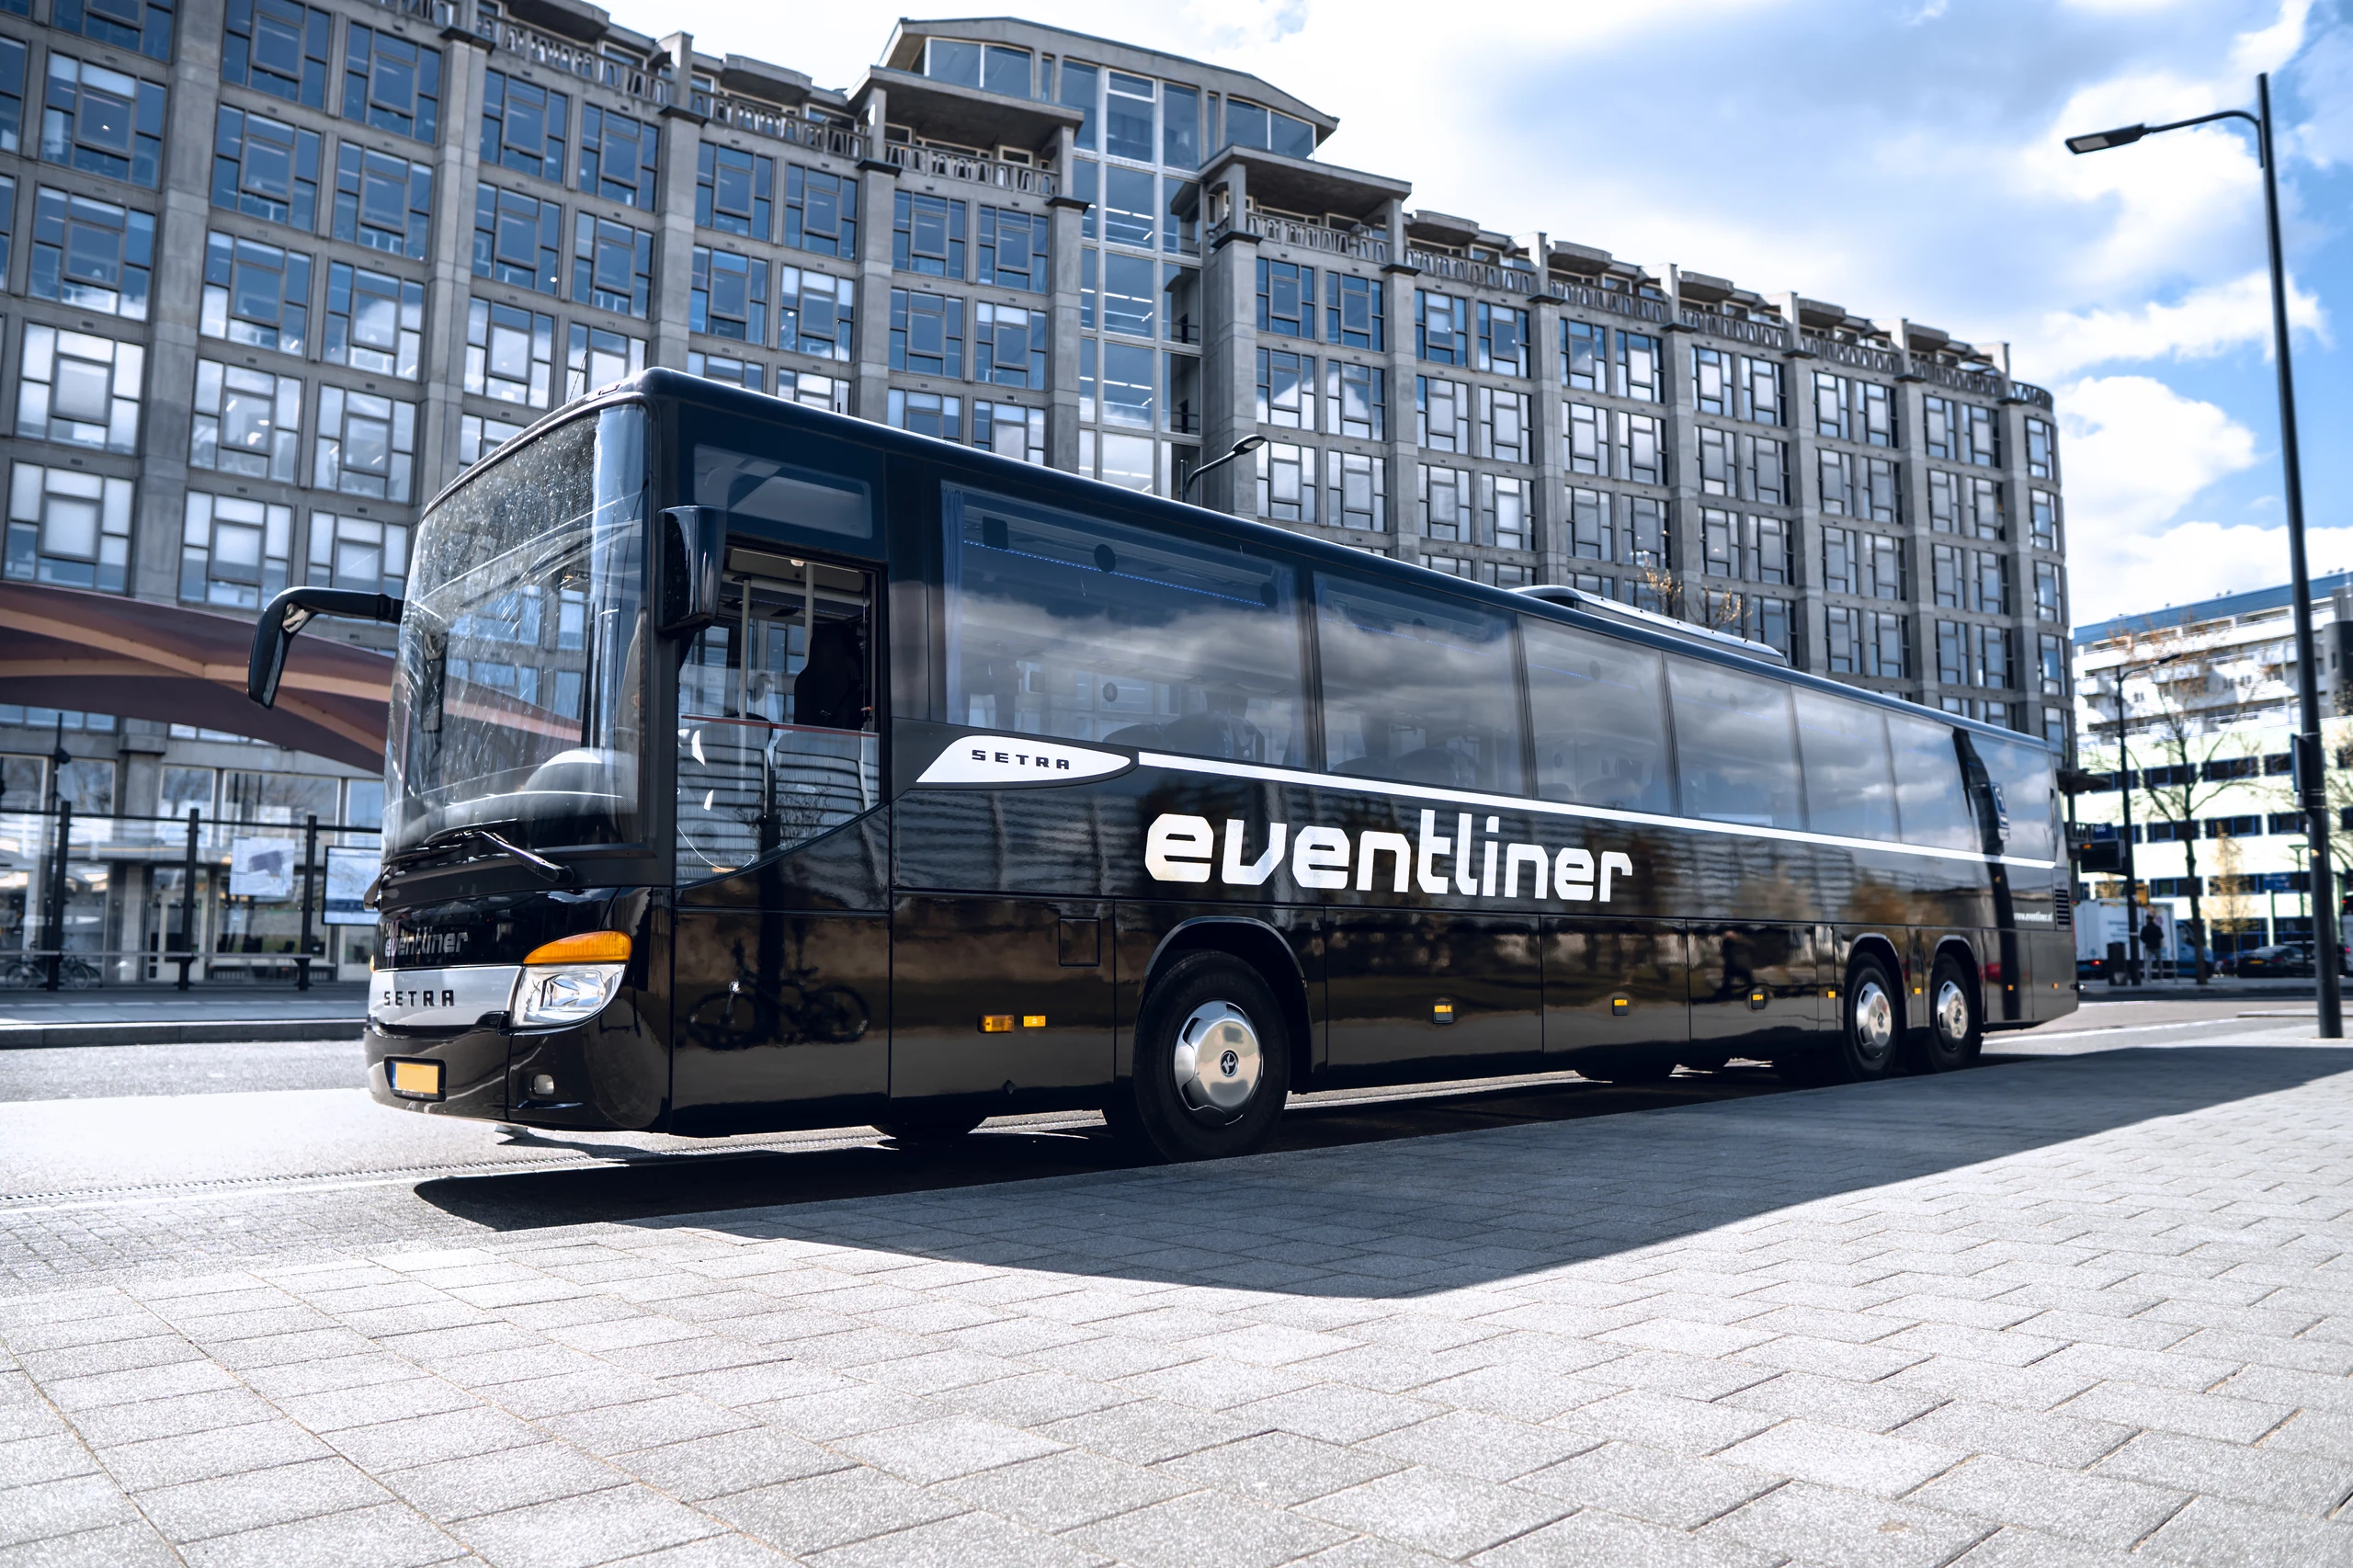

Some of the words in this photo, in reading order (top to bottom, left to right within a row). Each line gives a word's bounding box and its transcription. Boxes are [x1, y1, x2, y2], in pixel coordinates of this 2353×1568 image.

[972, 749, 1070, 770] SETRA
[1144, 809, 1633, 903] eventliner
[384, 926, 469, 957] eventliner
[383, 989, 455, 1007] SETRA
